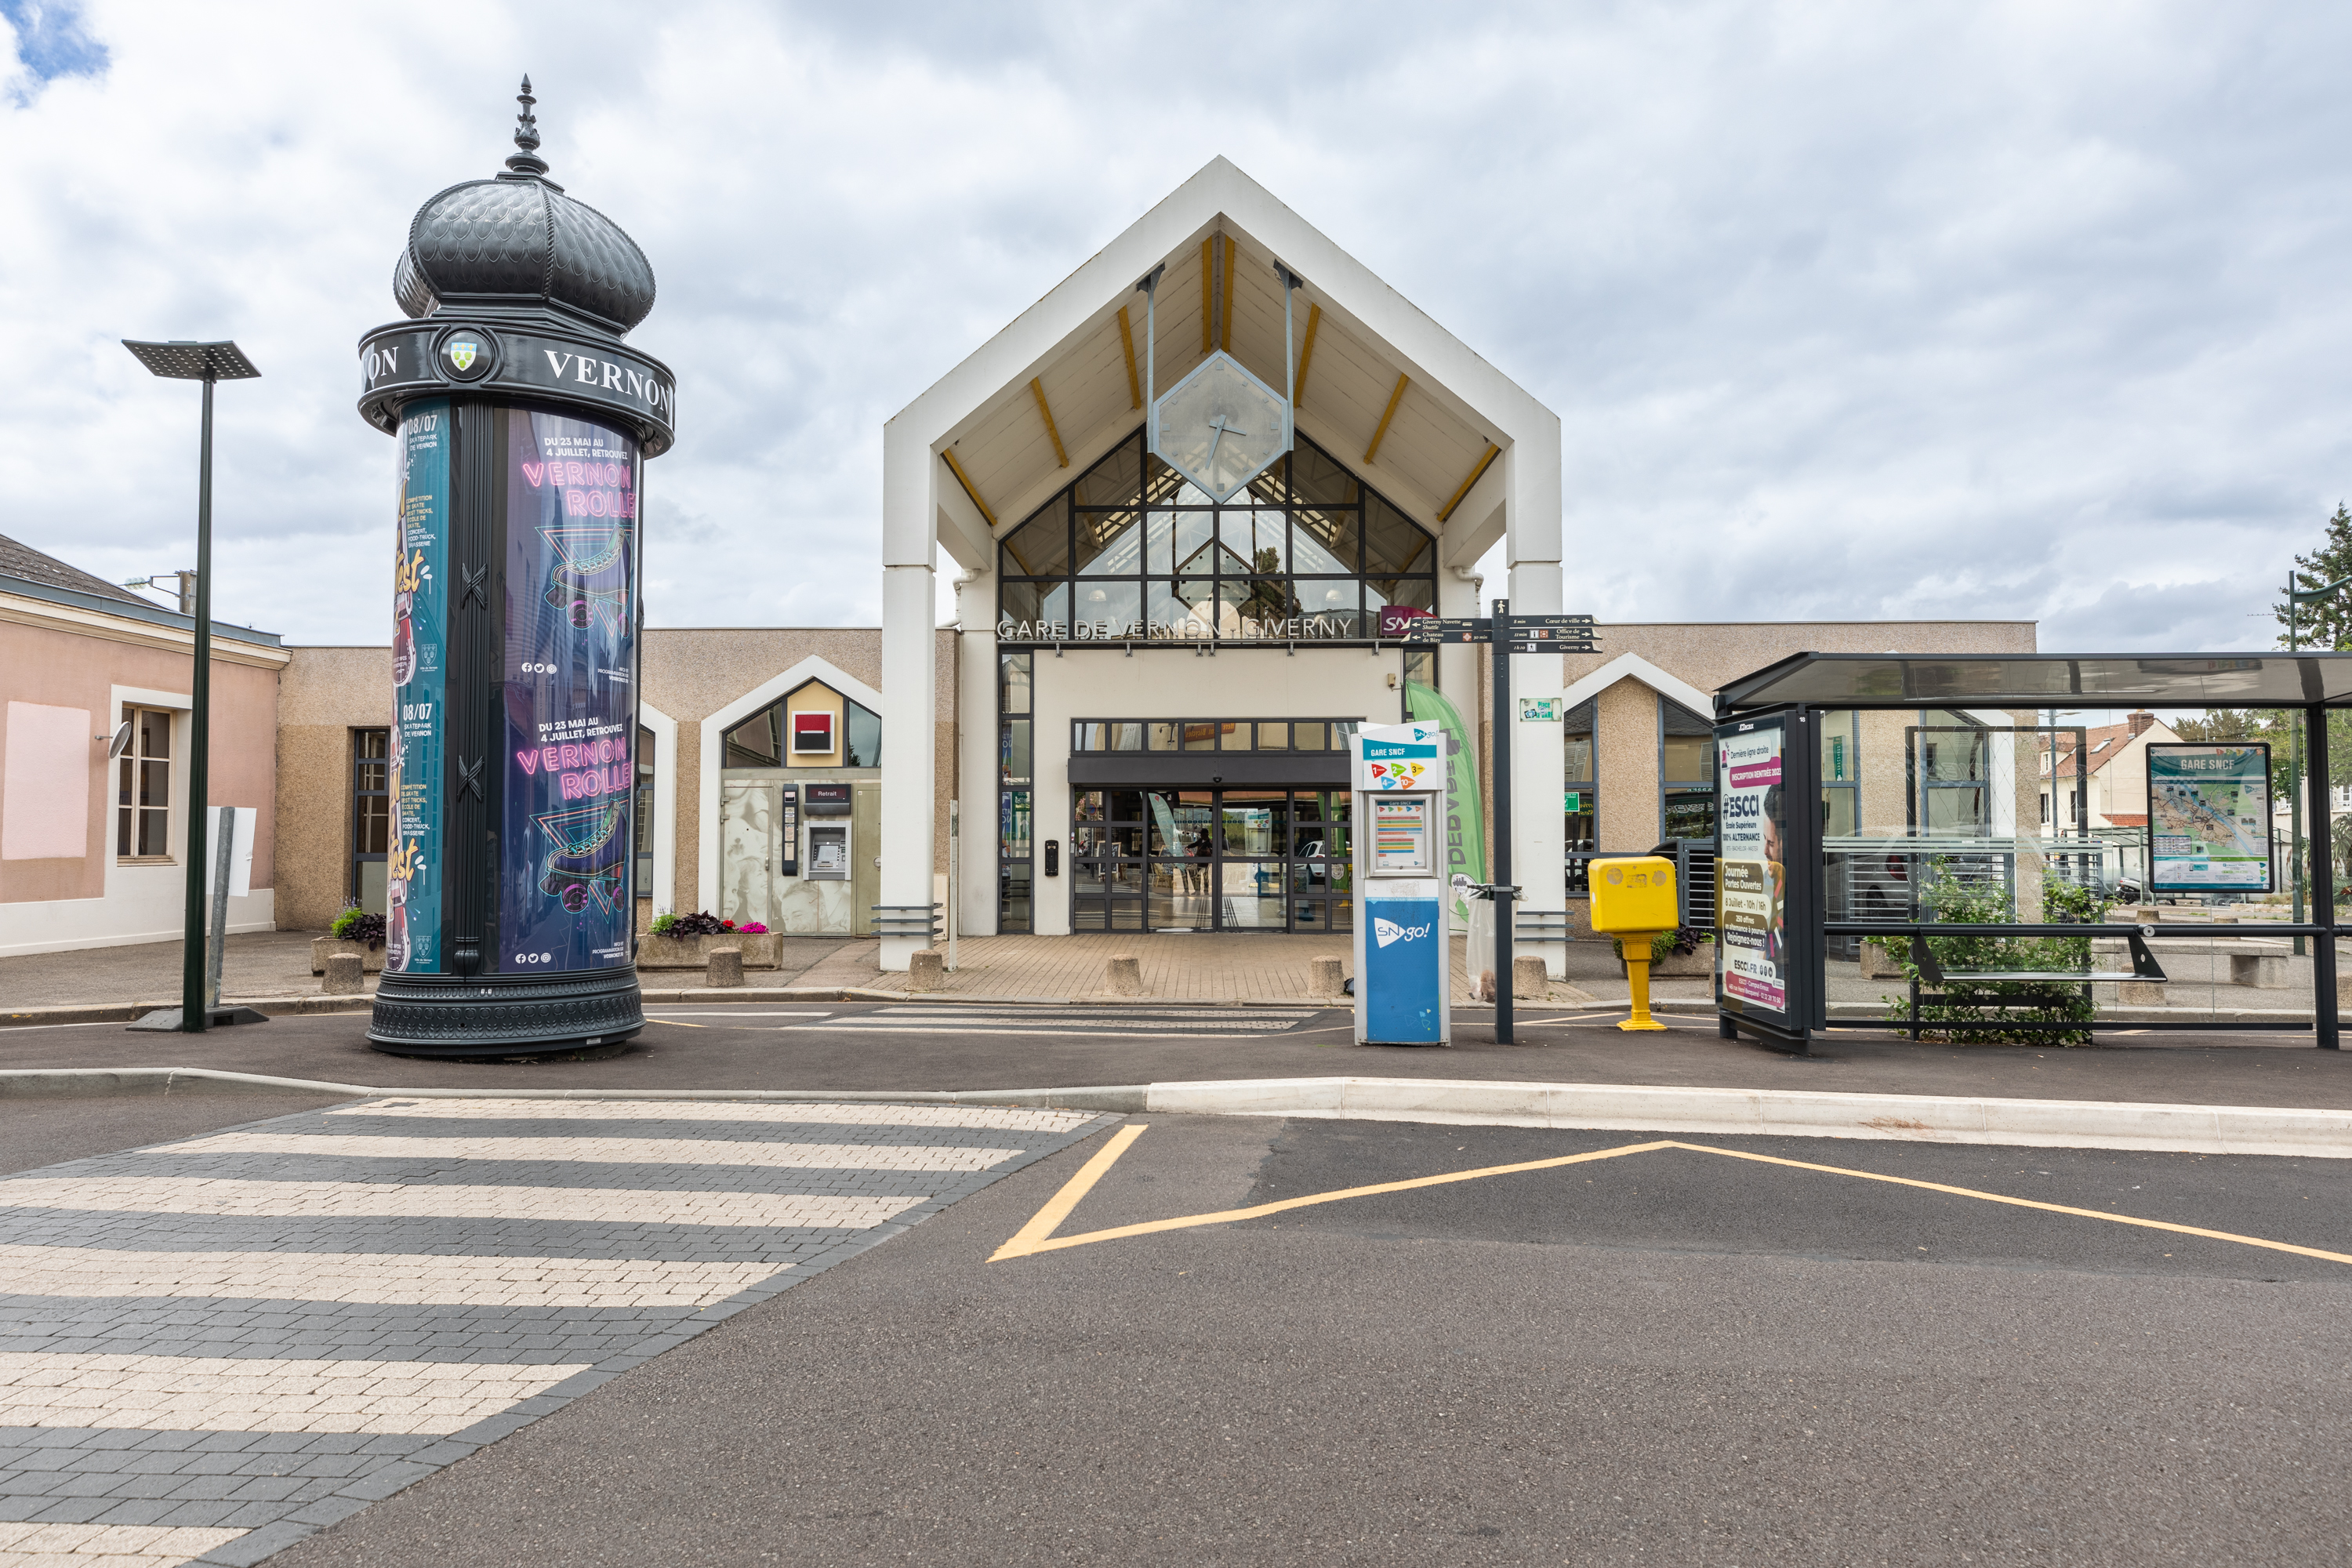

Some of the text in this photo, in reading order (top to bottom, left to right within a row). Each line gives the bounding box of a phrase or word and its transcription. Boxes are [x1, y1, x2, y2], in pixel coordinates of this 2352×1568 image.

[543, 350, 669, 416] VERNON
[408, 415, 437, 435] 08/07
[409, 434, 437, 444] SKATEPARK
[544, 437, 557, 446] DU
[573, 437, 591, 446] MAI
[593, 438, 604, 447] AU
[555, 448, 590, 458] JUILLET,
[592, 448, 628, 460] RETROUVEZ
[522, 462, 631, 489] VERNON
[406, 495, 432, 504] COMPÉTITION
[566, 489, 637, 518] ROLLE
[997, 619, 1064, 638] GARE
[1074, 619, 1107, 637] DE
[1115, 619, 1221, 637] VERNON
[1244, 619, 1352, 637] GIVERNY
[403, 703, 432, 720] 08/07
[539, 717, 599, 732] DU 23 MAI AU
[541, 724, 622, 742] 4 JUILLET, RETROUVEZ
[517, 736, 626, 775] VERNON
[1731, 746, 1769, 759] Dernière ligne droite
[2180, 760, 2234, 770] GARE SNCF
[561, 761, 633, 800] ROLLE
[1732, 771, 1754, 781] INSCRIPTION
[1754, 768, 1772, 778] RENTRÉE
[1736, 820, 1757, 830] Supérieure
[1732, 833, 1760, 841] ALTERNANCE
[1725, 866, 1748, 878] Journée
[1725, 879, 1762, 891] Portes Ouvertes
[1729, 898, 1743, 908] Juillet
[1747, 899, 1755, 909] 10h
[1743, 915, 1755, 924] offres
[1730, 924, 1748, 933] alternance
[1734, 960, 1757, 974] ESCCI.FR
